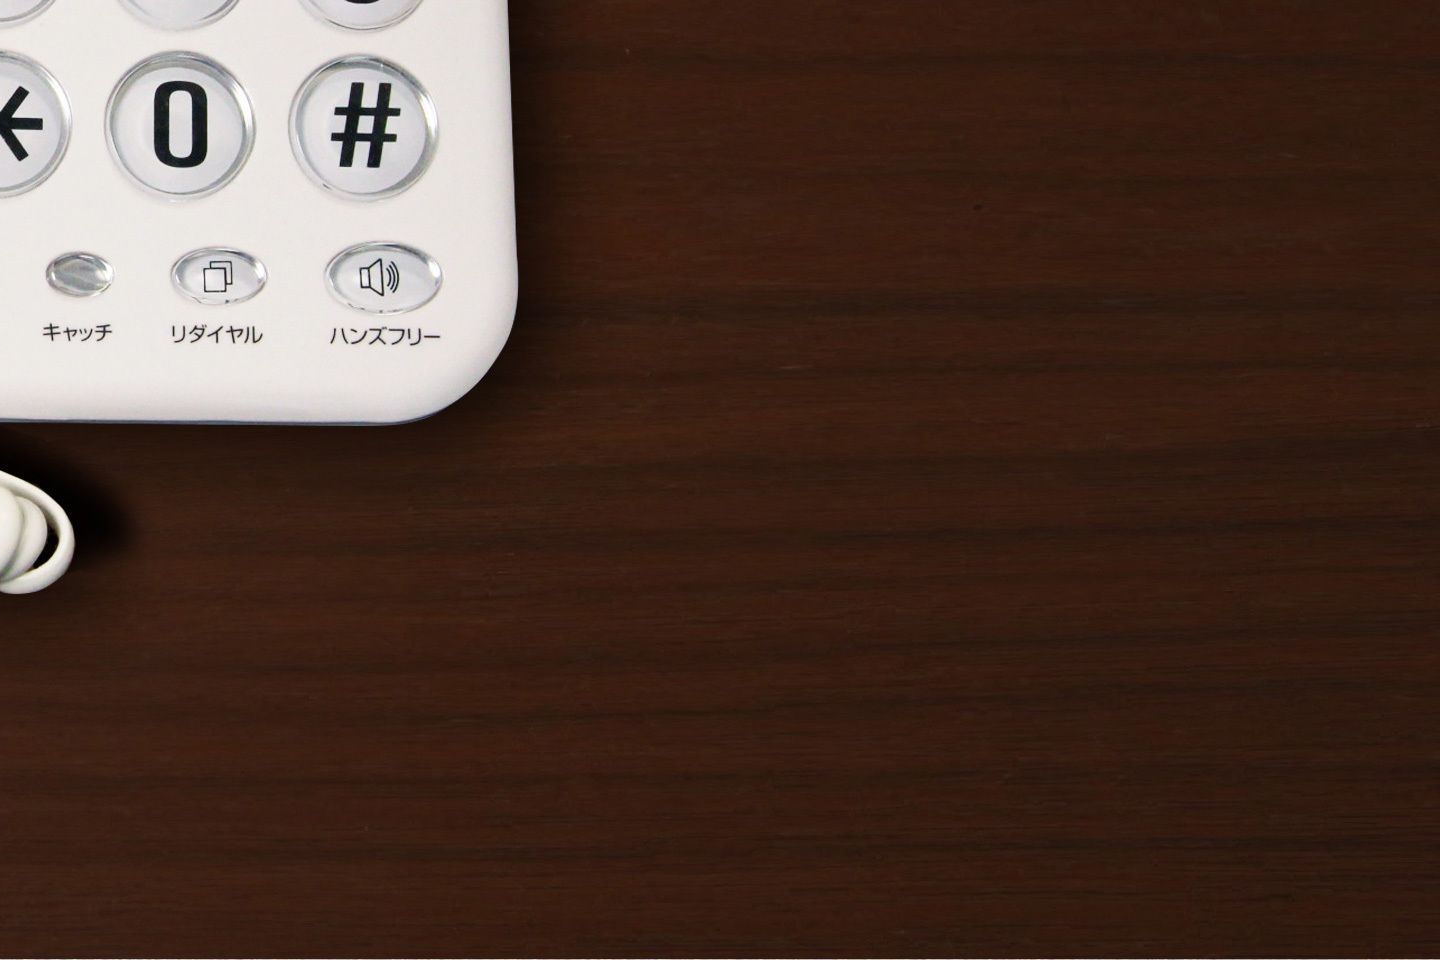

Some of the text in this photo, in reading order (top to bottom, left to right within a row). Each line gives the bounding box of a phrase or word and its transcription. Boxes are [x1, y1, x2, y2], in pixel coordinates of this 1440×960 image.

[154, 81, 207, 168] 0
[331, 83, 400, 168] #
[43, 323, 112, 341] キャッチ
[172, 325, 263, 343] リダイヤル
[330, 327, 440, 346] ハンズフリー
